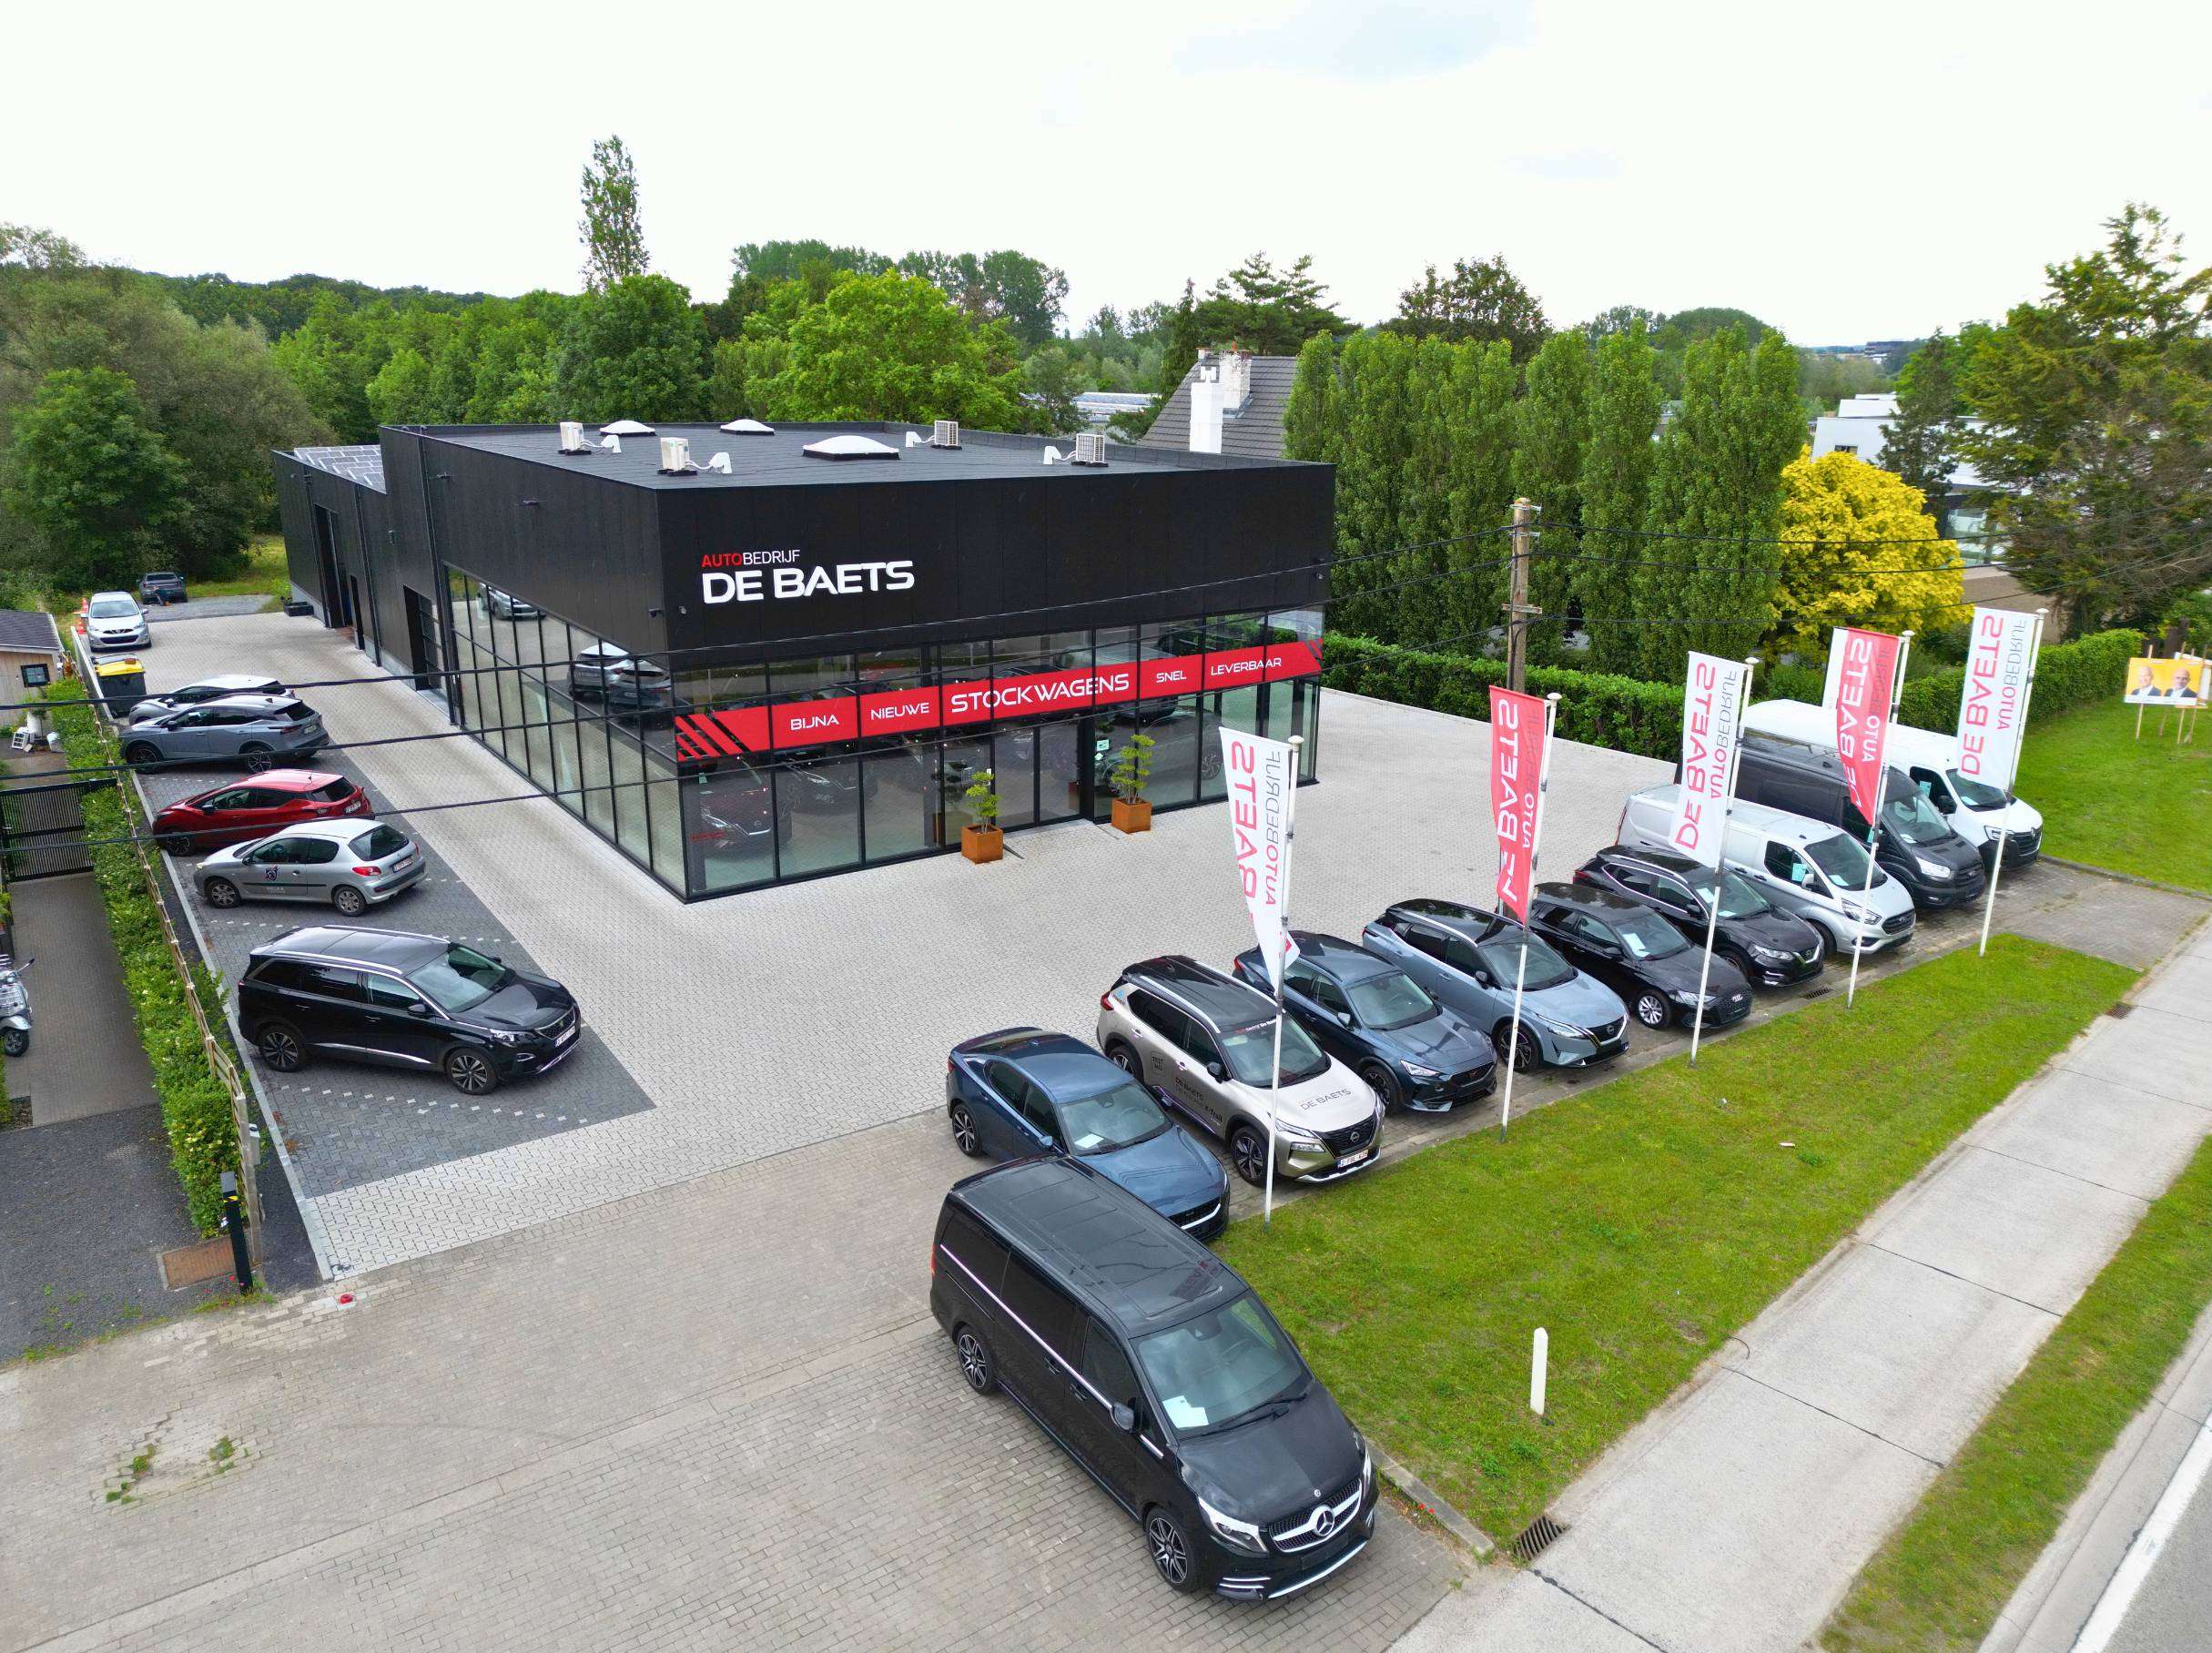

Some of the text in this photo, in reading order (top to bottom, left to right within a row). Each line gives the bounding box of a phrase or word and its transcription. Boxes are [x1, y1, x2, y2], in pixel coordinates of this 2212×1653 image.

[701, 549, 800, 568] AUTOBEDRIJF
[702, 560, 915, 603] DE BAETS
[790, 657, 1282, 731] BIJNA NIEUWE STOCKWAGENS SNEL LEVERBAAR
[1300, 1089, 1352, 1110] DE BAETS
